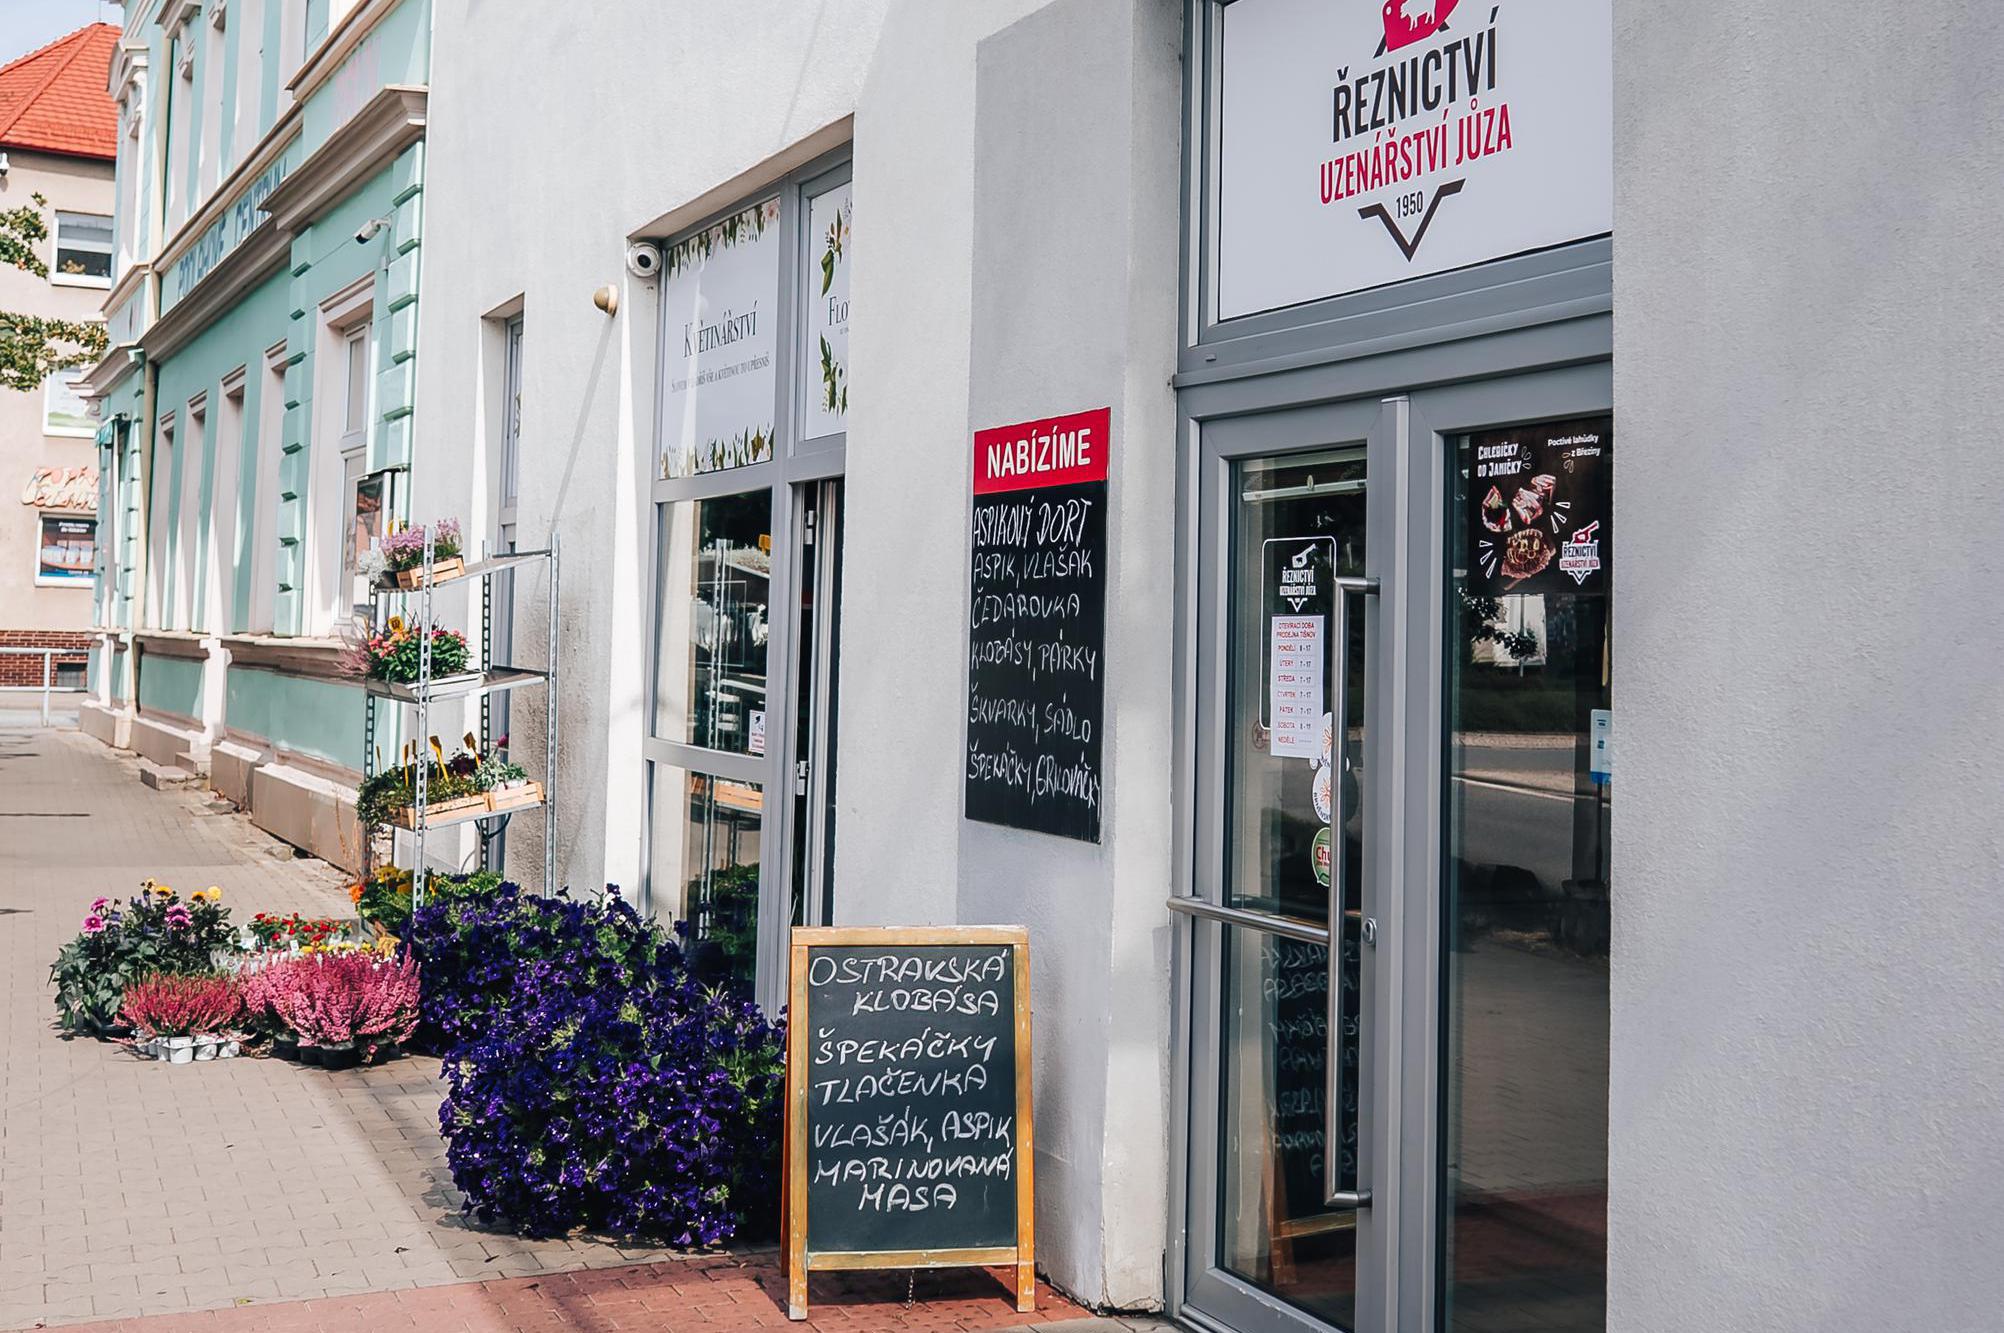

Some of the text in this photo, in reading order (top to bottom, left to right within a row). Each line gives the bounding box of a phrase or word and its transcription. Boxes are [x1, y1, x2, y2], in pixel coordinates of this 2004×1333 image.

[1332, 5, 1500, 143] ŘEZNICTVÍ
[1320, 98, 1513, 205] UZENÁŘSTVÍ JŮZA
[1395, 190, 1424, 219] 1950
[987, 425, 1091, 480] NABÍZÍME
[1477, 464, 1487, 478] OD
[973, 495, 1093, 549] ASPIKOVÝ DORT
[1038, 629, 1096, 682] PÁRKY
[1044, 692, 1091, 743] SÁDLO
[808, 948, 1009, 987] OSTRAVSKÁ
[852, 984, 999, 1017] KLOBÁSA
[814, 1026, 997, 1066] ŠPEKÁČKY
[814, 1064, 987, 1106] TLAČENKA
[942, 1110, 1013, 1148] ASPIK
[814, 1146, 1015, 1187] MARINOVANÁ
[858, 1183, 958, 1213] MASA
